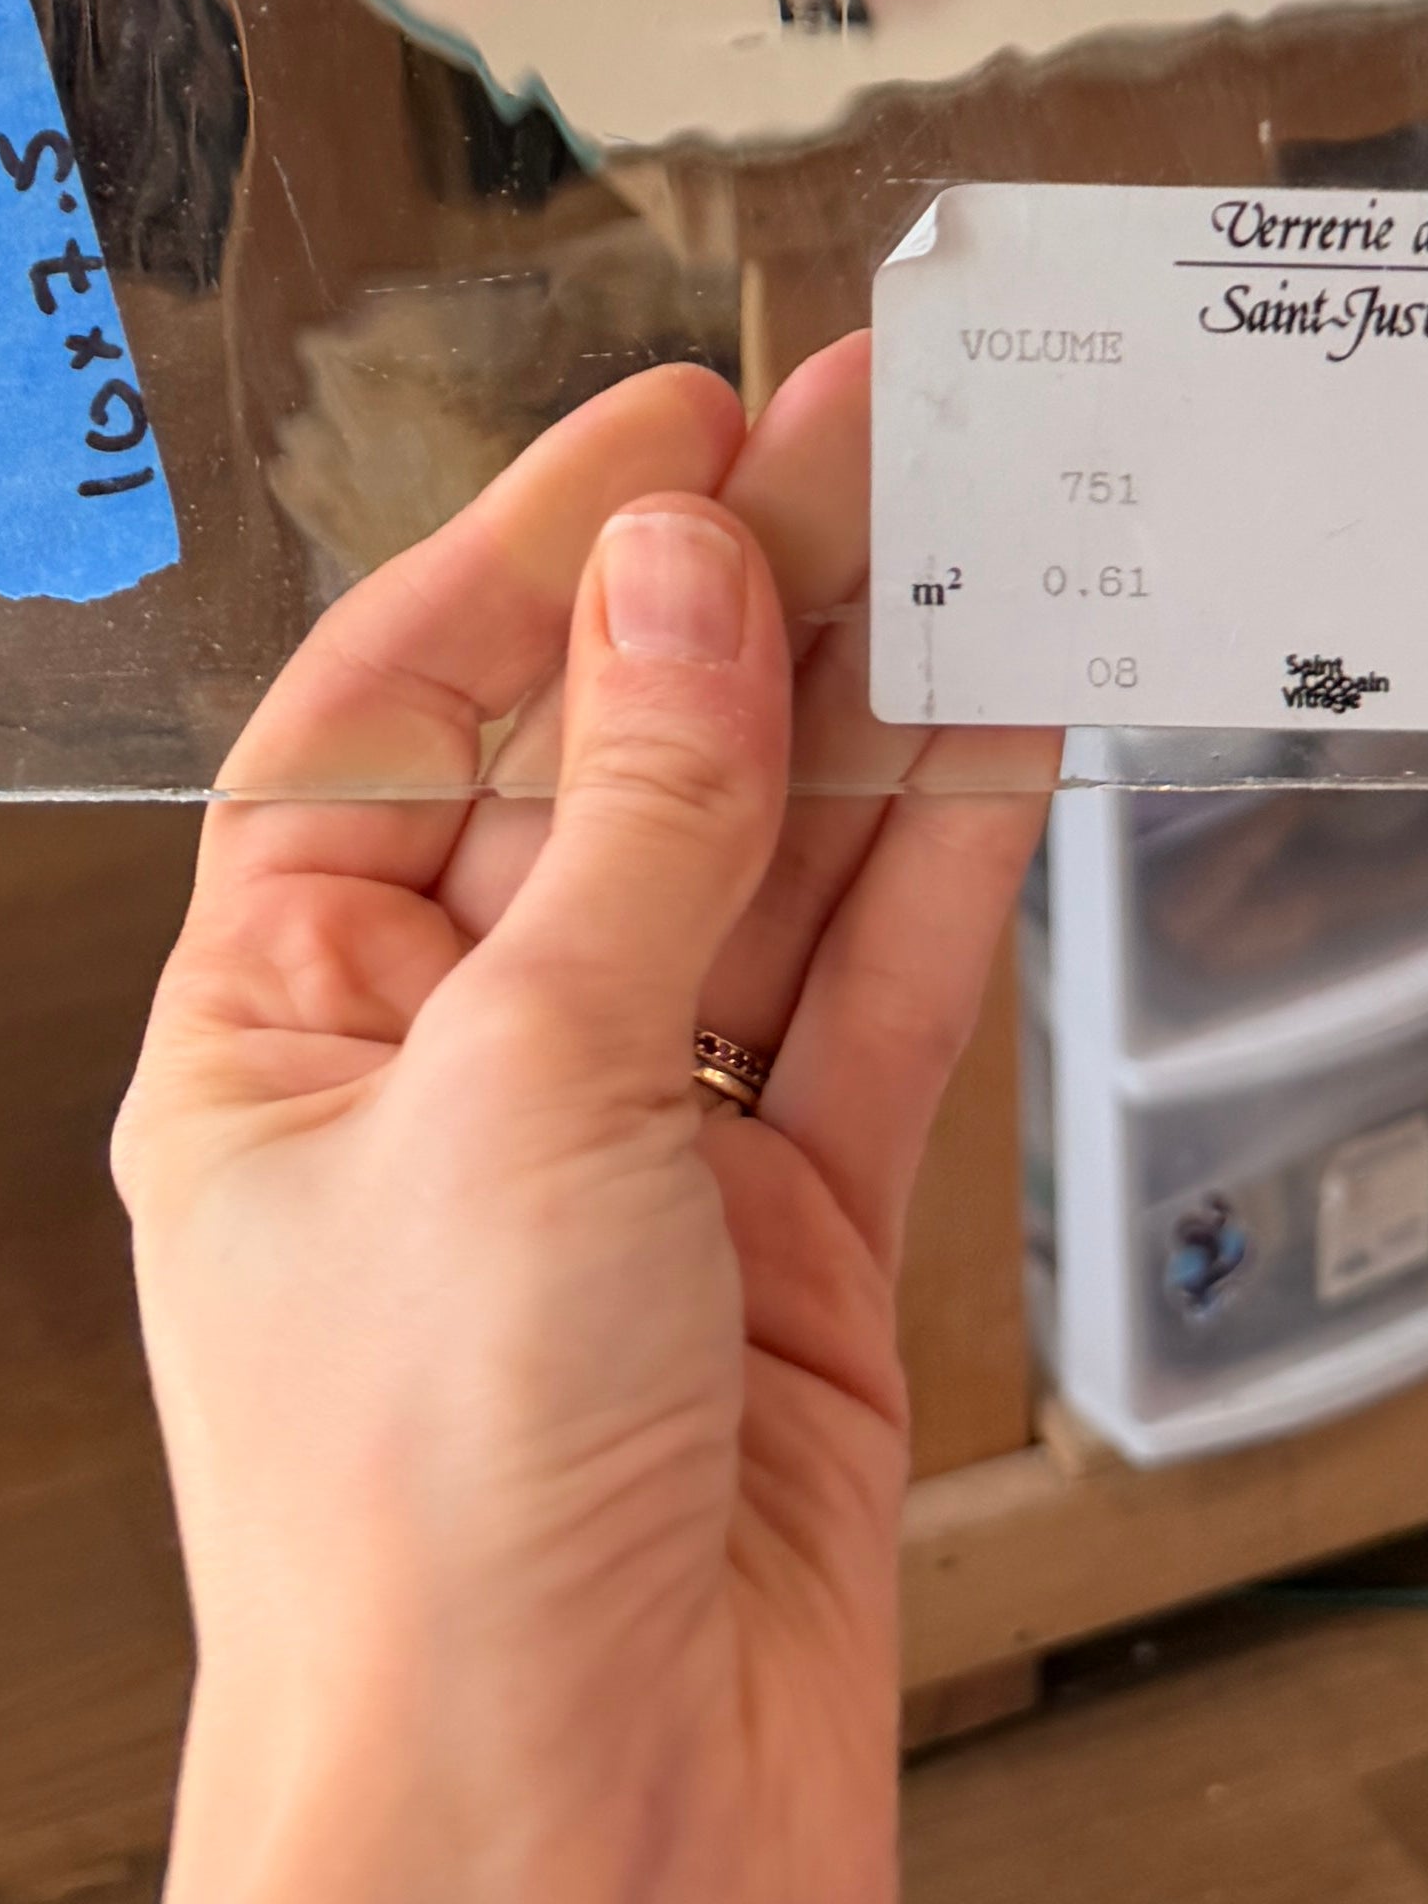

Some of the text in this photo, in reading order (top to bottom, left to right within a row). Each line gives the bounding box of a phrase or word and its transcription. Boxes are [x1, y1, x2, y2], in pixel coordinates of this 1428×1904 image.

[1210, 197, 1396, 254] Verrerie
[959, 328, 1124, 366] VOLUME
[1059, 471, 1139, 506] 751
[1042, 565, 1151, 599] 0.61
[1086, 657, 1139, 689] 08
